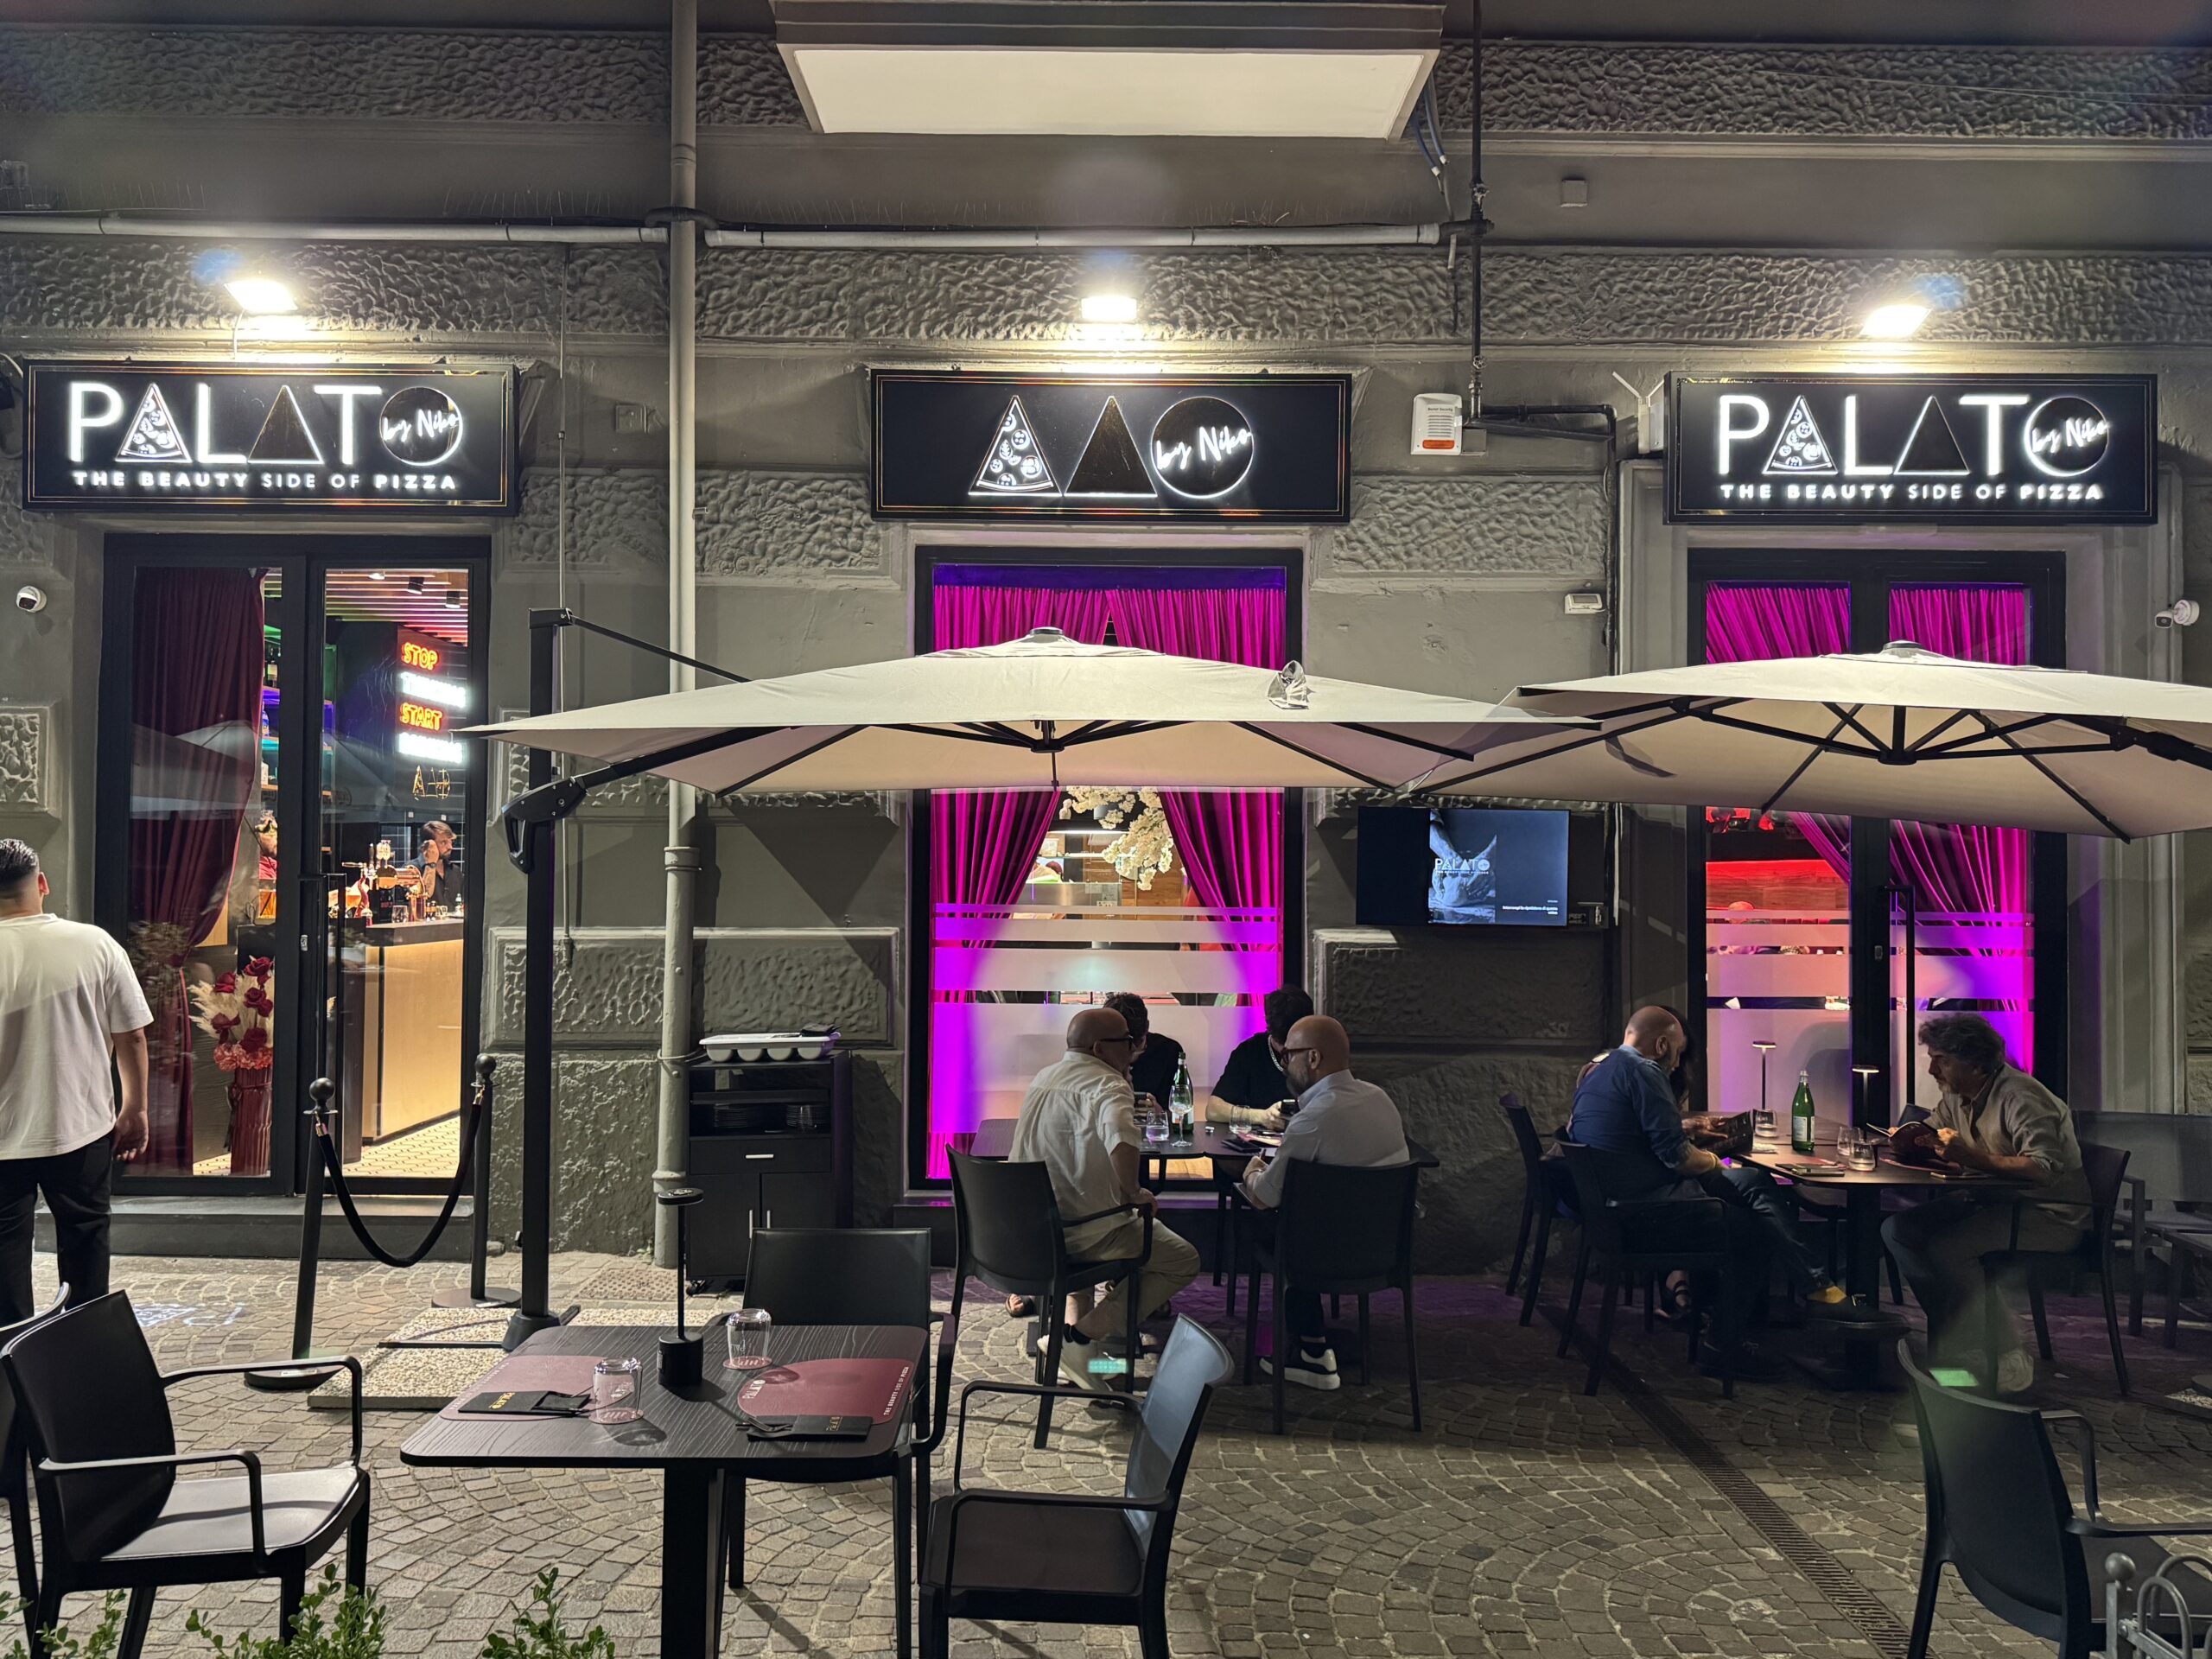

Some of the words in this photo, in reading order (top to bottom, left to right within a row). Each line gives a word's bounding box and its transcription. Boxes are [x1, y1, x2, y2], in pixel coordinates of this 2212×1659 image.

[67, 381, 463, 466] PALATO
[383, 416, 412, 442] by
[1719, 394, 2109, 477] PALATO
[1156, 439, 1192, 470] by
[73, 472, 125, 487] THE
[139, 472, 249, 489] BEAUTY
[262, 473, 315, 490] SIDE
[331, 474, 360, 490] OF
[375, 474, 456, 491] PIZZA
[1721, 483, 1771, 499] THE
[1787, 484, 1893, 500] BEAUTY
[1908, 483, 1962, 500] SIDE
[1975, 484, 2008, 500] OF
[2020, 484, 2104, 501] PIZZA
[403, 642, 438, 671] STOP
[400, 702, 442, 731] START
[1434, 858, 1491, 871] PALATO
